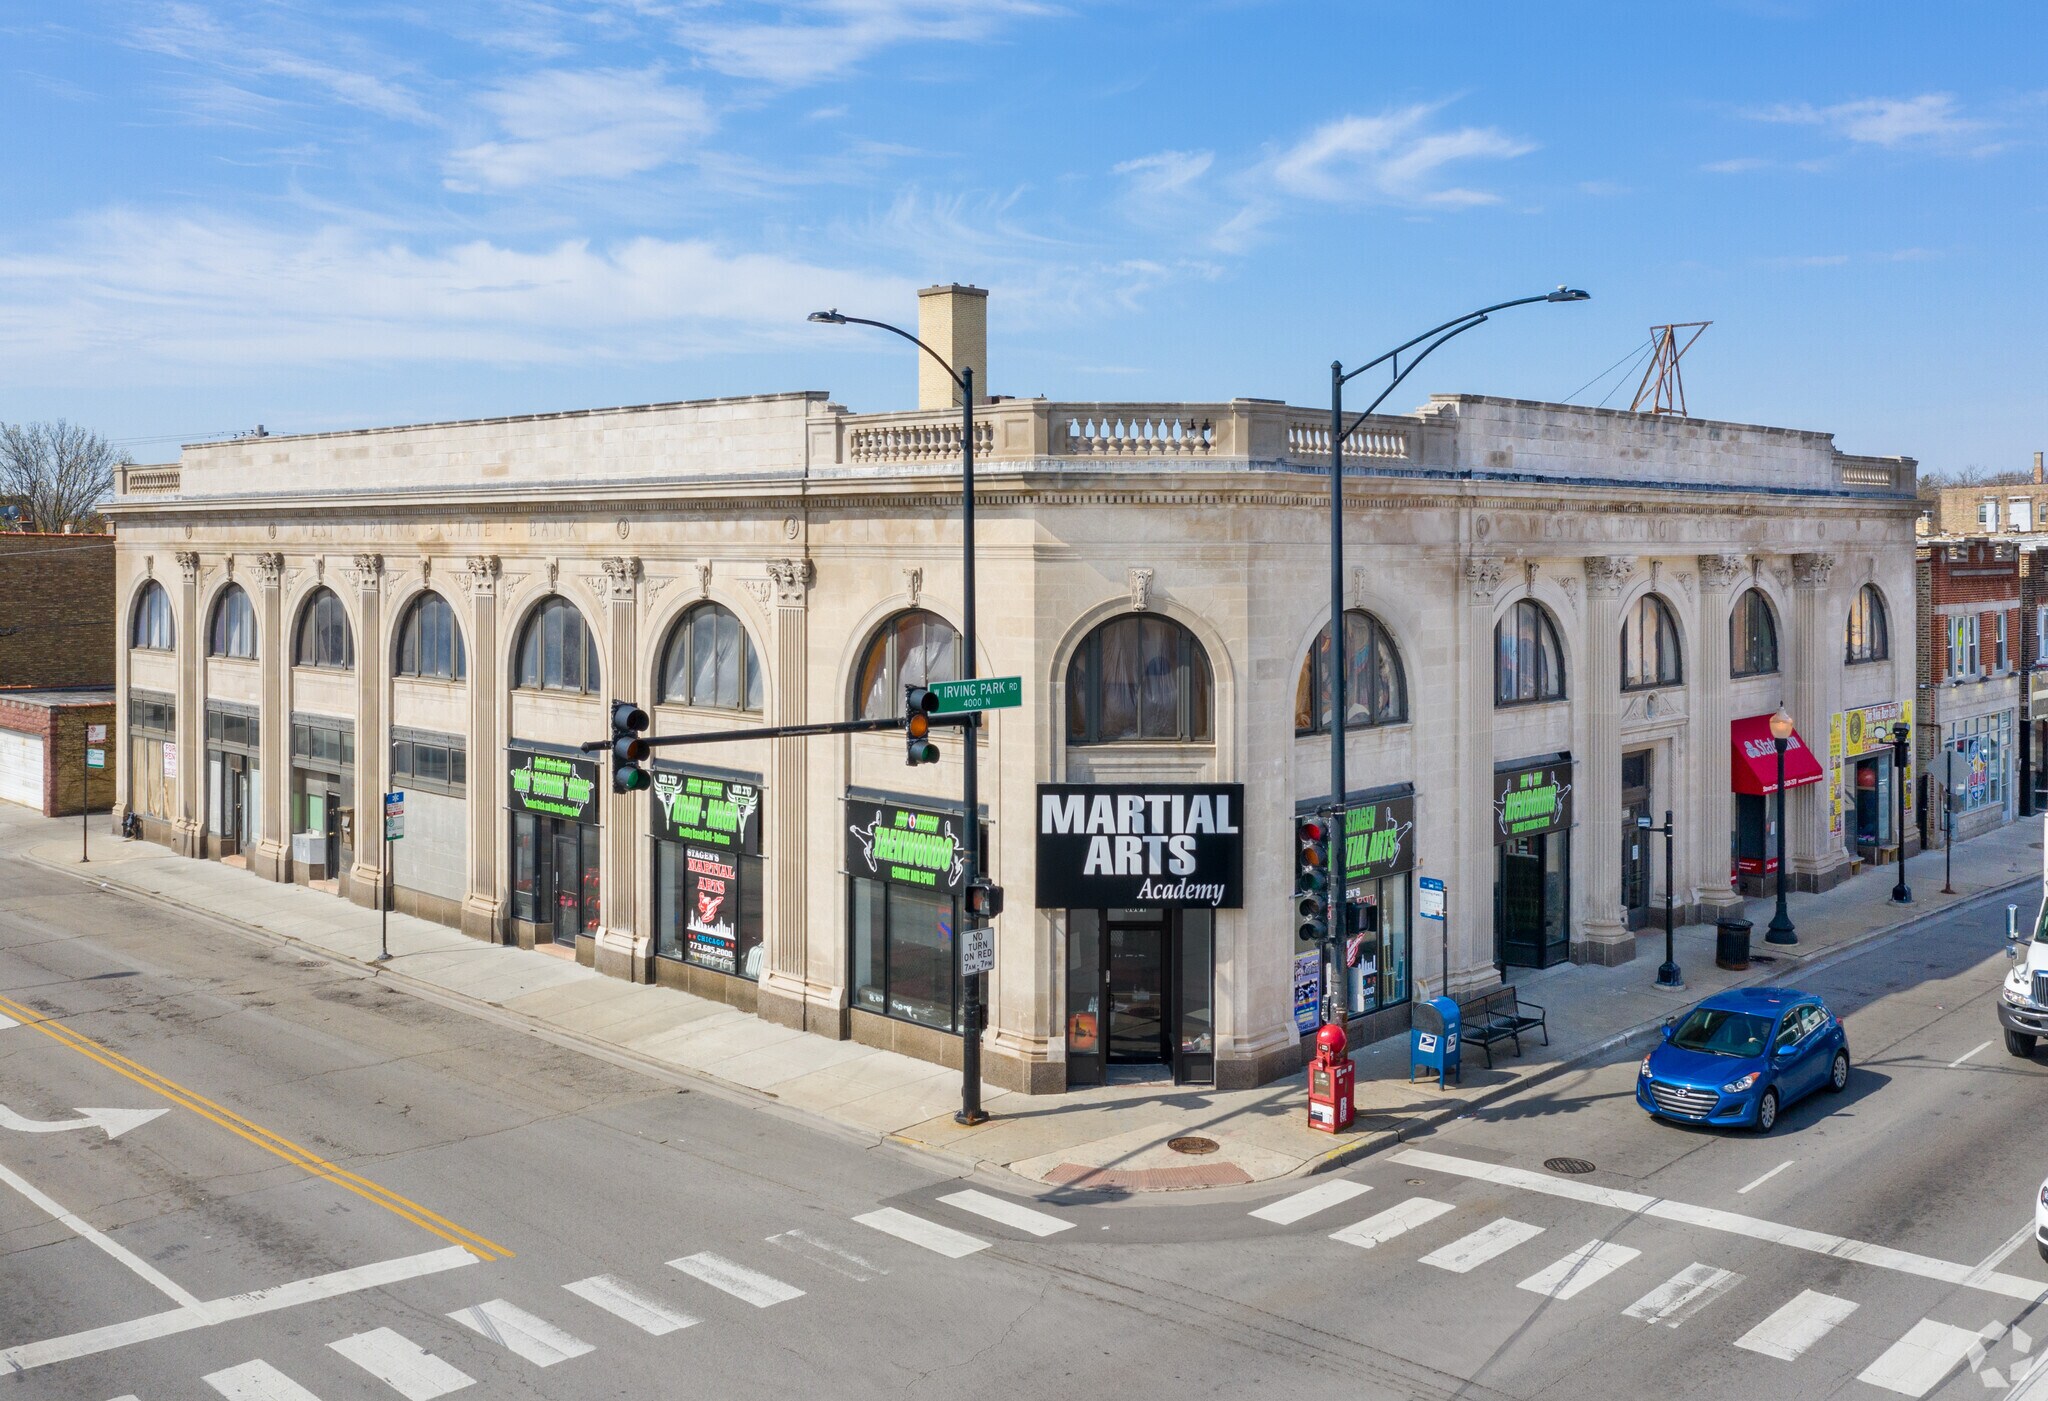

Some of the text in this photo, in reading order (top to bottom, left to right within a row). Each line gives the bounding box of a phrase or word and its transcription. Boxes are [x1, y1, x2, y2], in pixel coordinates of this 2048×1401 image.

[302, 519, 577, 538] WEST IRVING STATE BANK
[1529, 518, 1574, 538] WEST
[1609, 518, 1667, 538] IRVING
[1696, 519, 1736, 538] STATE
[943, 683, 976, 698] IRVING
[980, 681, 1006, 696] PARK
[1008, 682, 1018, 691] RD
[963, 697, 991, 708] 4000 N
[164, 751, 176, 761] REN
[672, 794, 703, 827] KRAV
[706, 798, 739, 833] MAGA
[1041, 794, 1239, 834] MARTIAL
[873, 826, 954, 872] TAEKWONDO
[1083, 835, 1197, 875] ARTS
[1367, 828, 1398, 863] ARTS
[687, 848, 720, 863] STAGEN'S
[688, 857, 736, 880] MARTIAL
[891, 865, 936, 886] COMBAT AND SPORT
[697, 876, 726, 895] ARTS
[1137, 877, 1225, 906] Academy
[696, 934, 725, 947] CHICAGO
[968, 940, 988, 951] TURN
[972, 932, 983, 942] NO
[964, 948, 992, 962] ON RED
